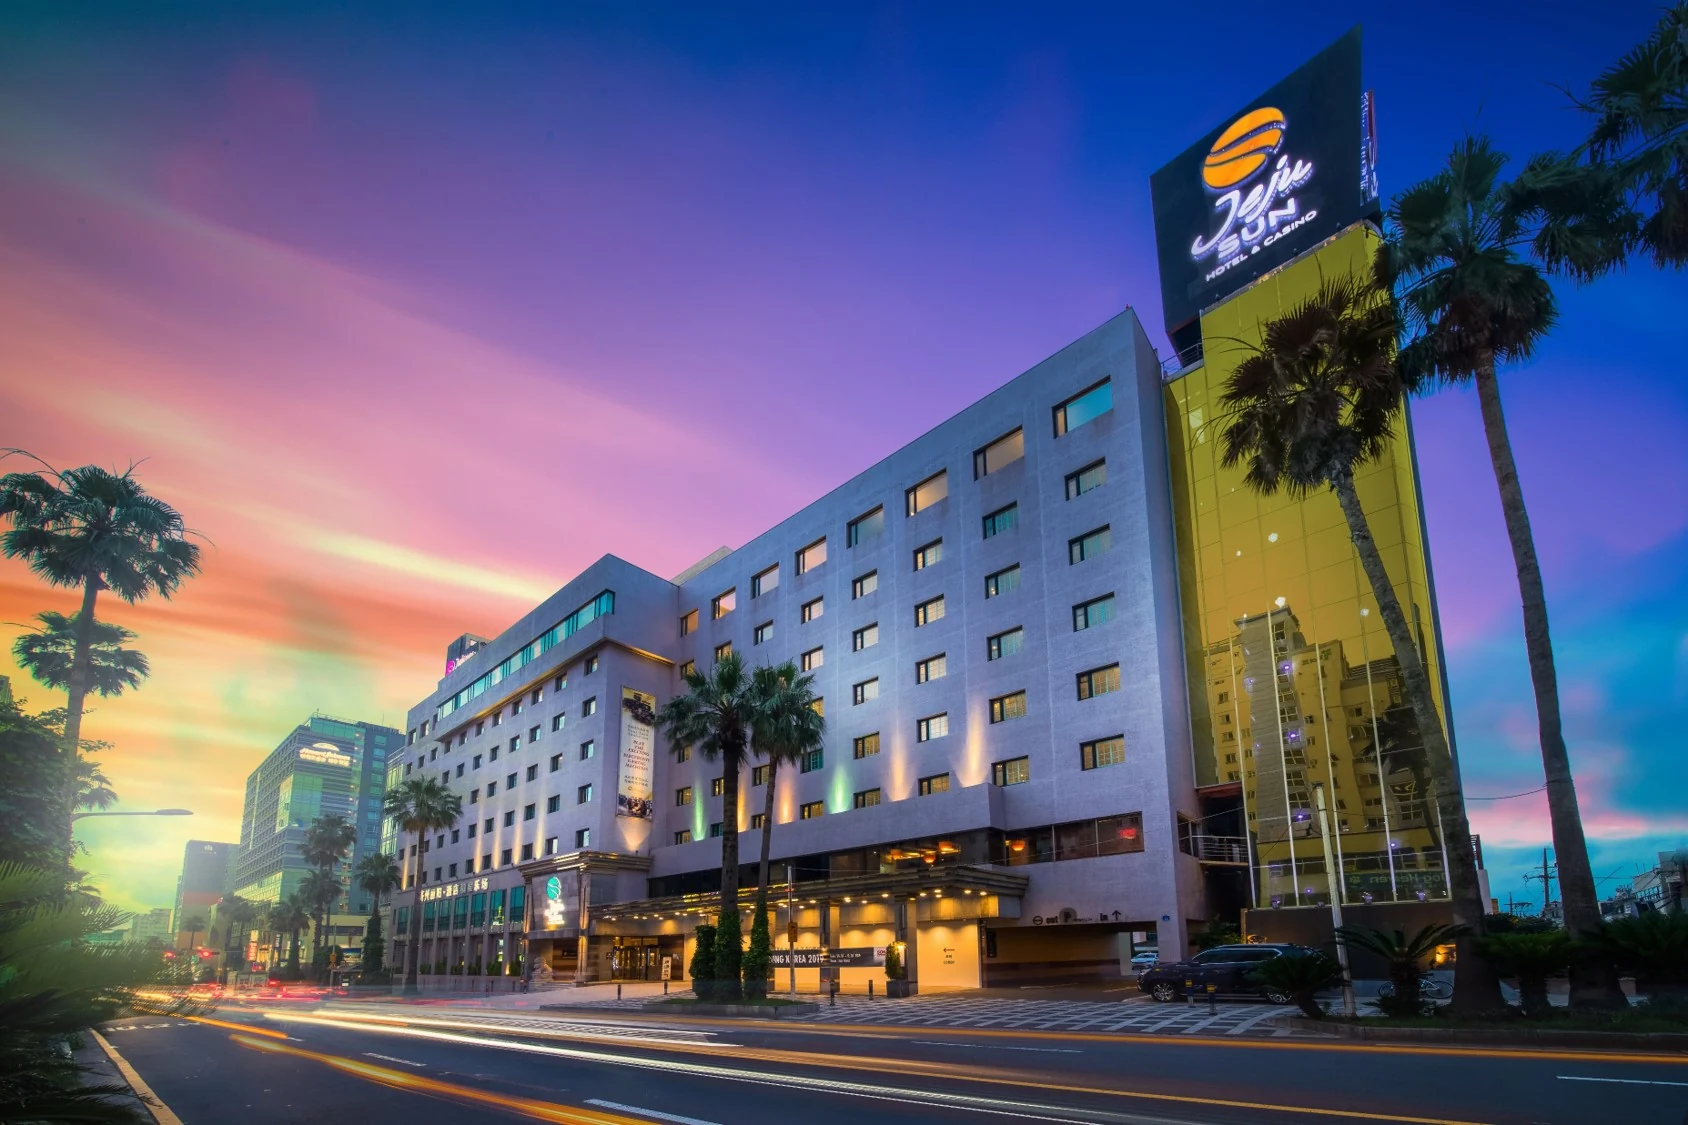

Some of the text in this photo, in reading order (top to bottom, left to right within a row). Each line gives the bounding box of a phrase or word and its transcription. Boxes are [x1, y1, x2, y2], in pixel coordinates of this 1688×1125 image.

[1191, 155, 1313, 256] Jeju
[1217, 197, 1297, 259] SUN
[1205, 253, 1249, 282] HOTEL
[1262, 210, 1318, 247] CASINO
[785, 954, 807, 964] KREA
